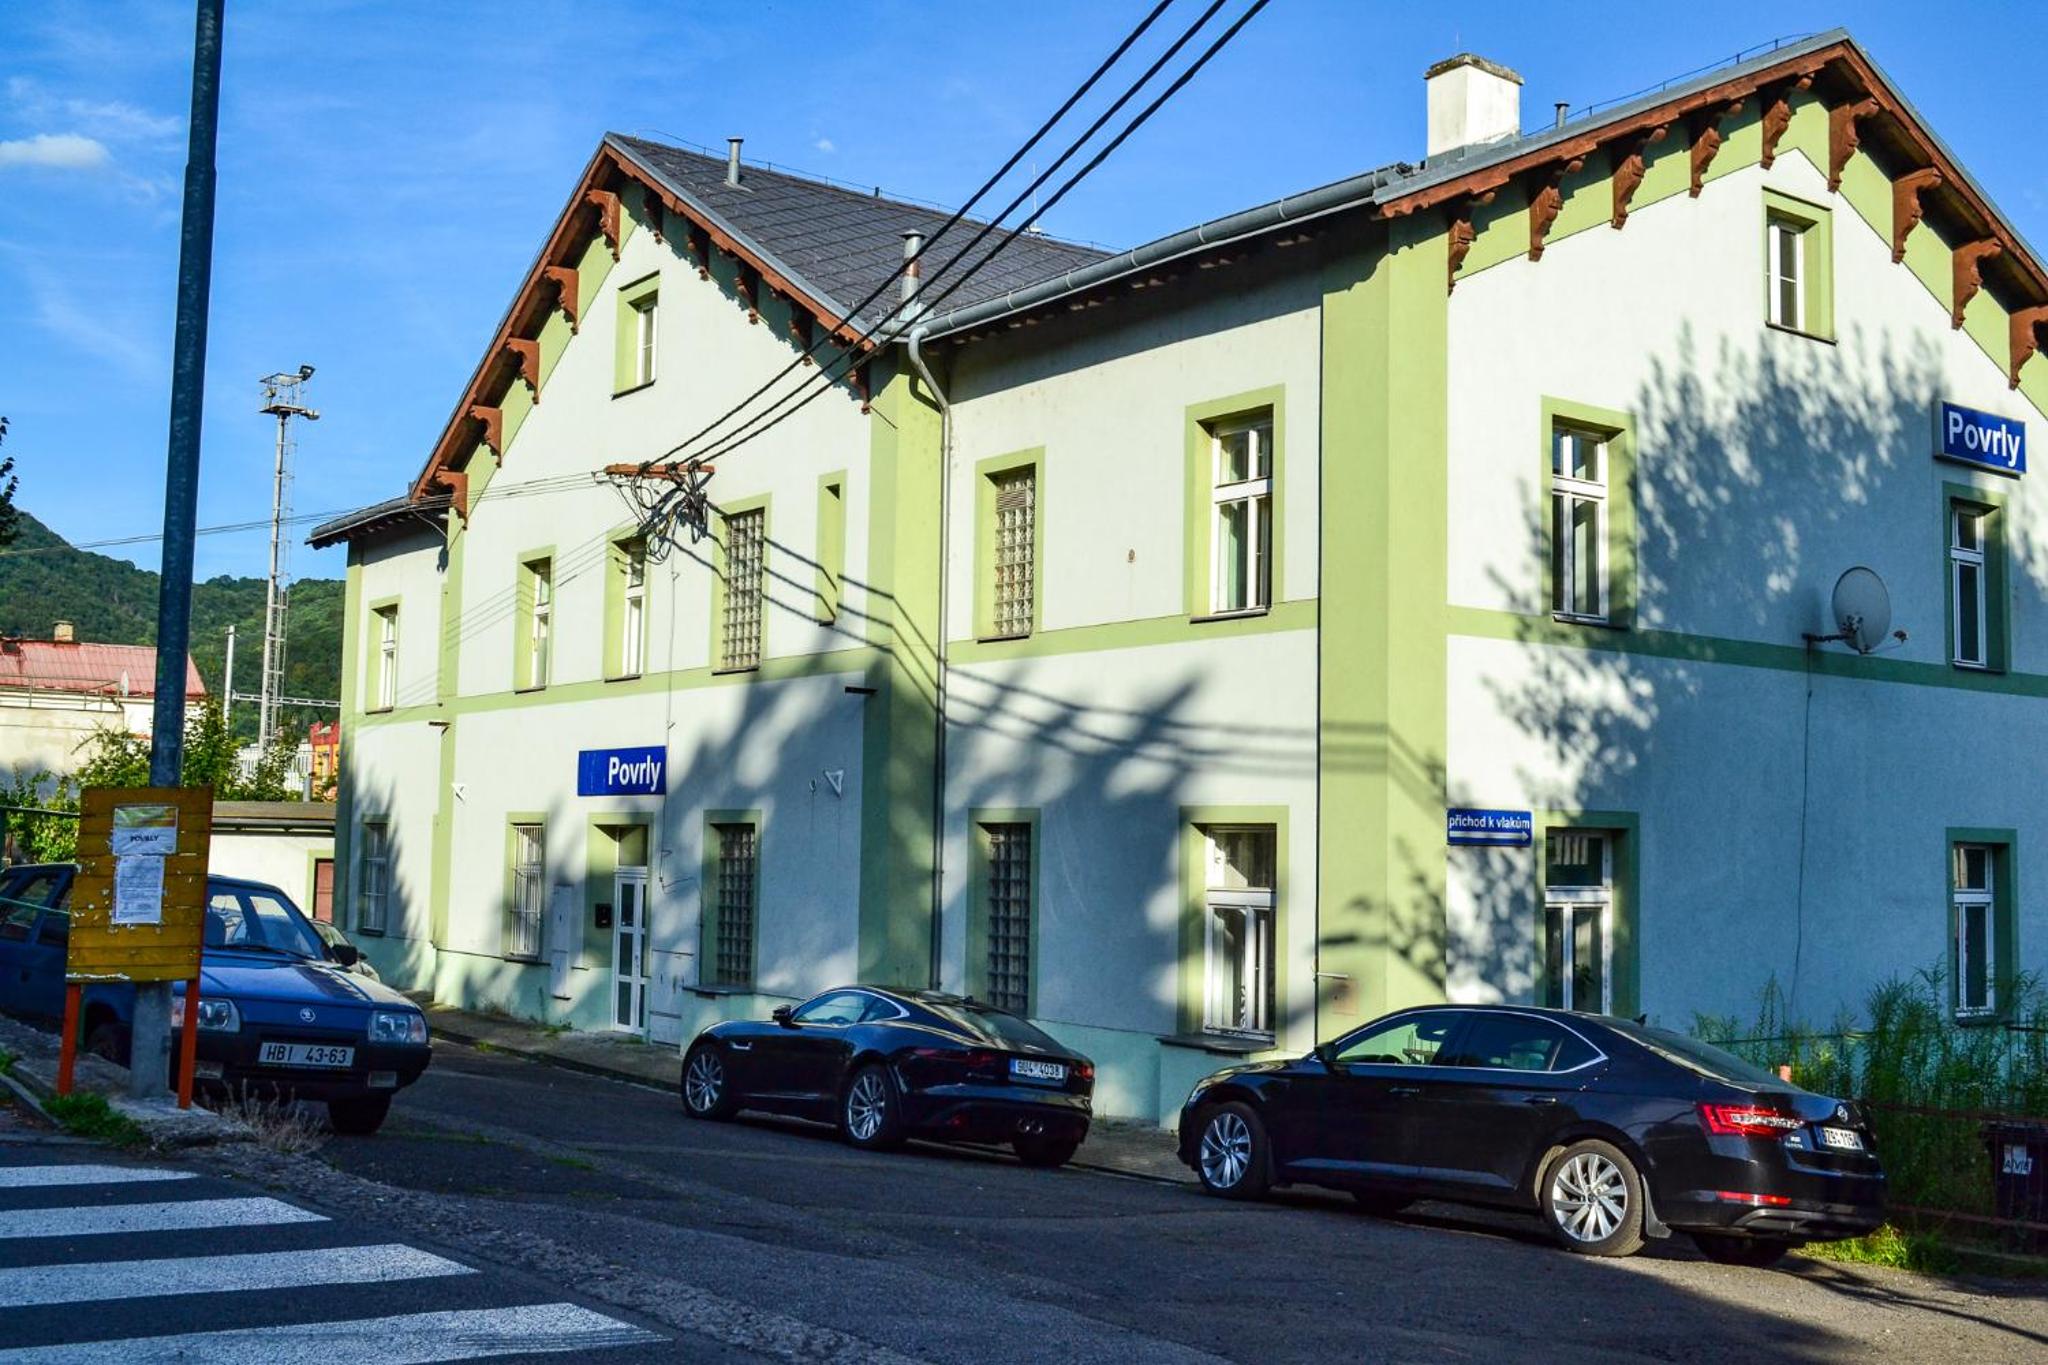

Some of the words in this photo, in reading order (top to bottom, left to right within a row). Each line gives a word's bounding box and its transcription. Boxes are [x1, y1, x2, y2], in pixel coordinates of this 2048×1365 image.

[1948, 411, 2020, 467] Povrly
[608, 754, 661, 792] Povrly
[1449, 814, 1486, 829] příchod
[1488, 815, 1494, 828] k
[1496, 816, 1530, 829] vlakům
[266, 1045, 294, 1061] HBI
[305, 1047, 347, 1063] 43-63
